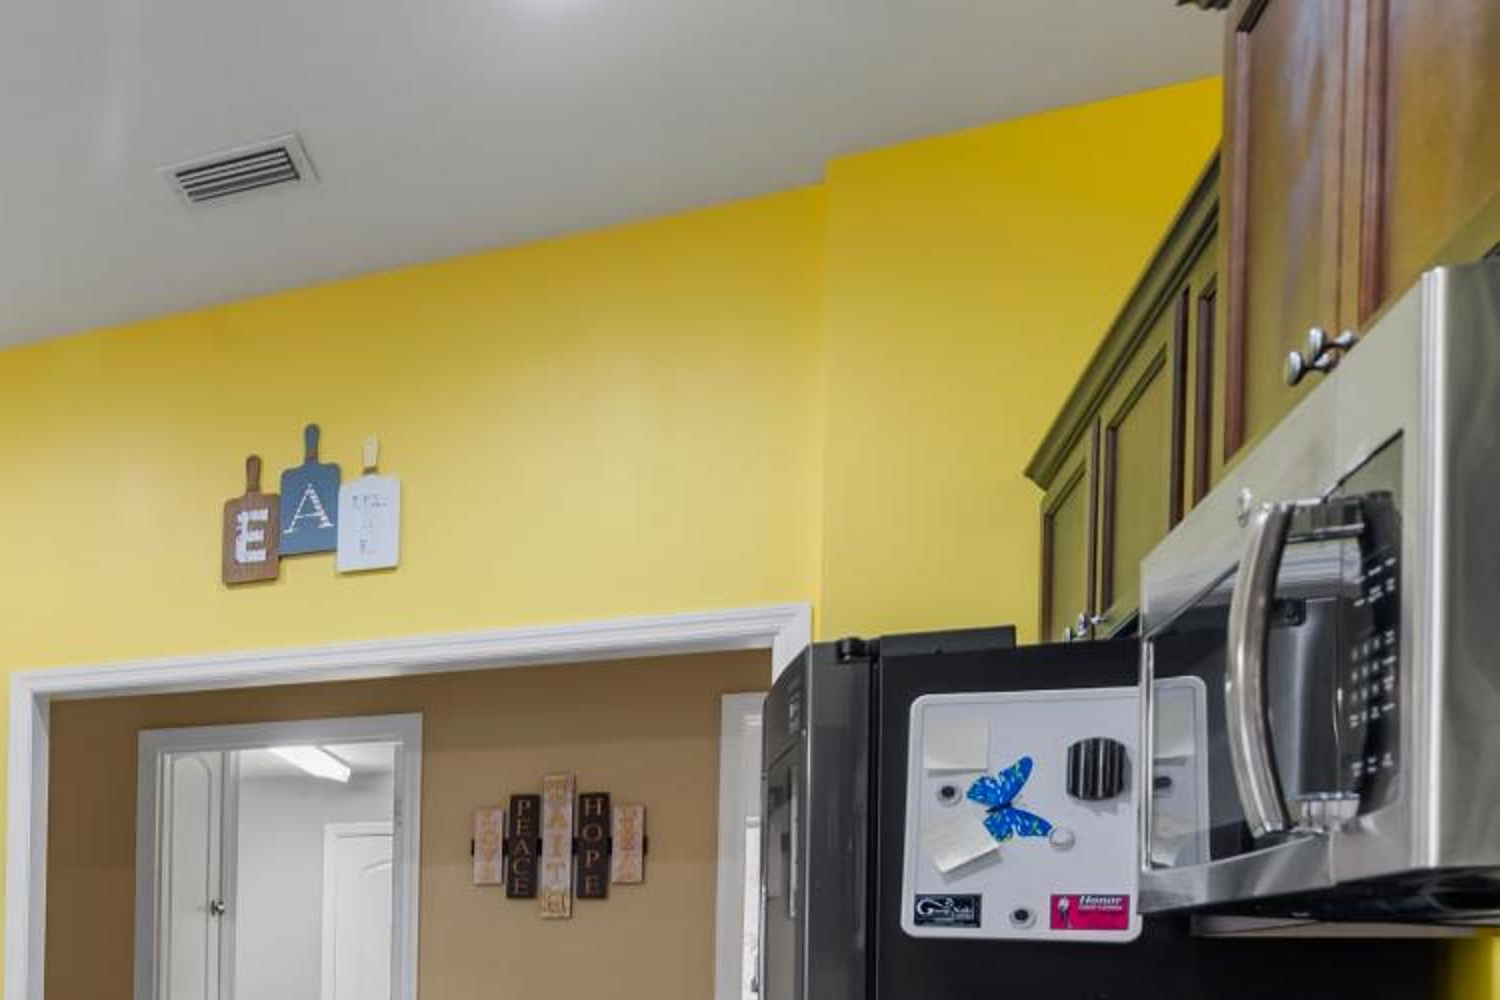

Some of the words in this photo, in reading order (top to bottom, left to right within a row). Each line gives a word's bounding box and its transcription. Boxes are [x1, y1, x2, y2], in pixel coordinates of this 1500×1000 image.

[236, 508, 270, 563] E
[283, 482, 335, 535] A
[513, 799, 532, 895] PEACE
[582, 798, 604, 894] HOPE
